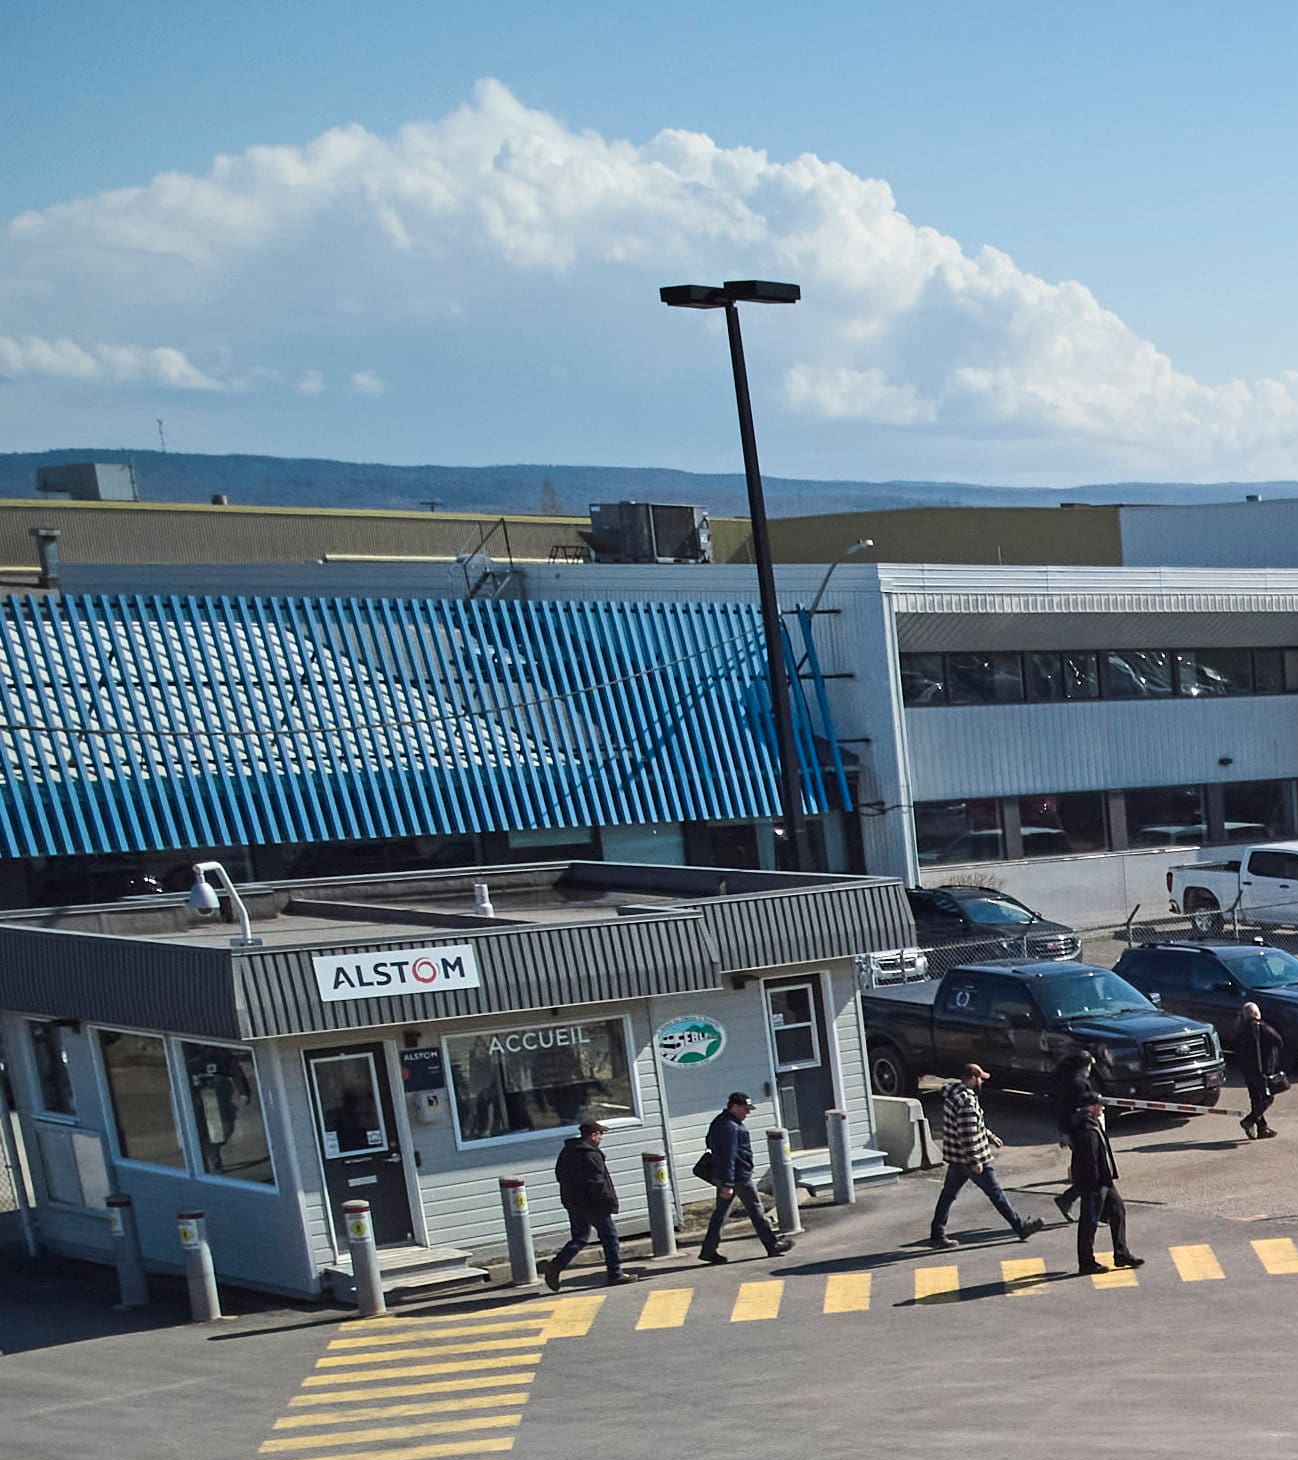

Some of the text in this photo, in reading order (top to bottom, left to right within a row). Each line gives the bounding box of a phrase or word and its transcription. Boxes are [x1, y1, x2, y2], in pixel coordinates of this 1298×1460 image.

[333, 956, 466, 990] ALSTOM
[403, 1050, 438, 1061] ALSTOM
[488, 1026, 592, 1056] ACCUEIL
